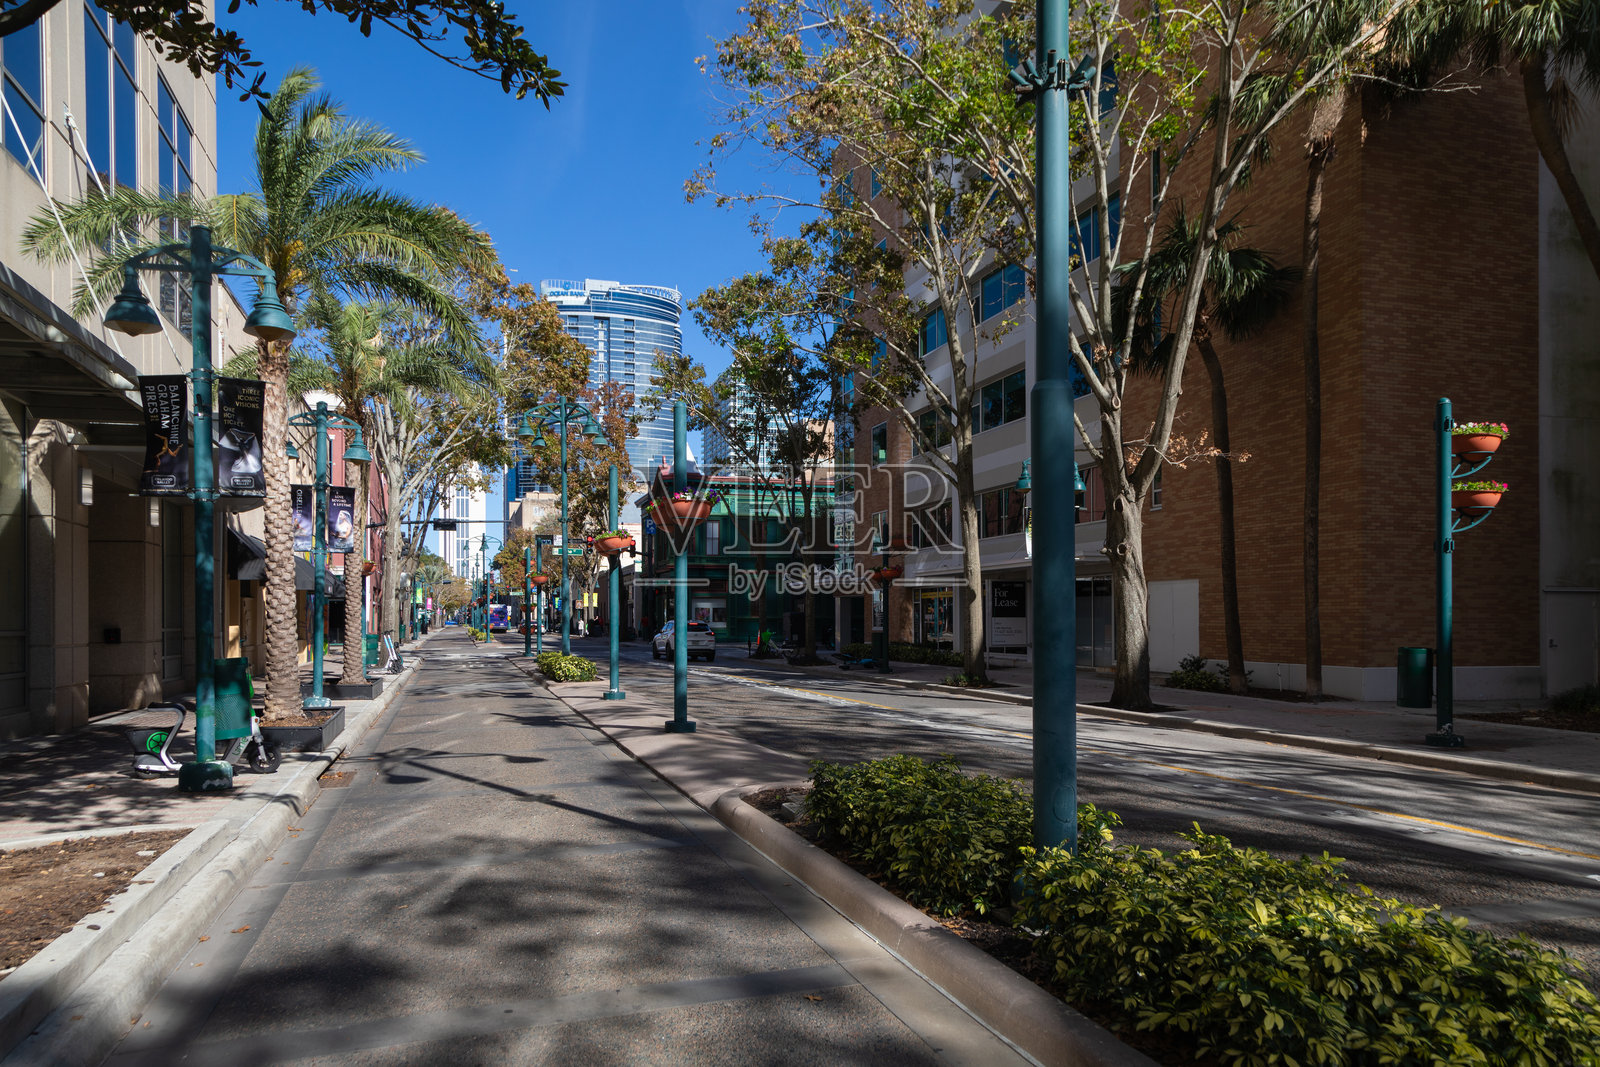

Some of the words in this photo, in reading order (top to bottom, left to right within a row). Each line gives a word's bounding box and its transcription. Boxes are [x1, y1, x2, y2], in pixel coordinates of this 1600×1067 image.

[242, 388, 261, 396] THREE
[144, 385, 159, 415] PIRES
[237, 394, 260, 402] ICONIC
[157, 383, 171, 429] GRAHAM
[169, 385, 180, 444] BALANCHINE
[223, 412, 236, 420] HOT
[646, 518, 654, 528] P
[994, 588, 1009, 598] For
[994, 597, 1018, 607] Lease
